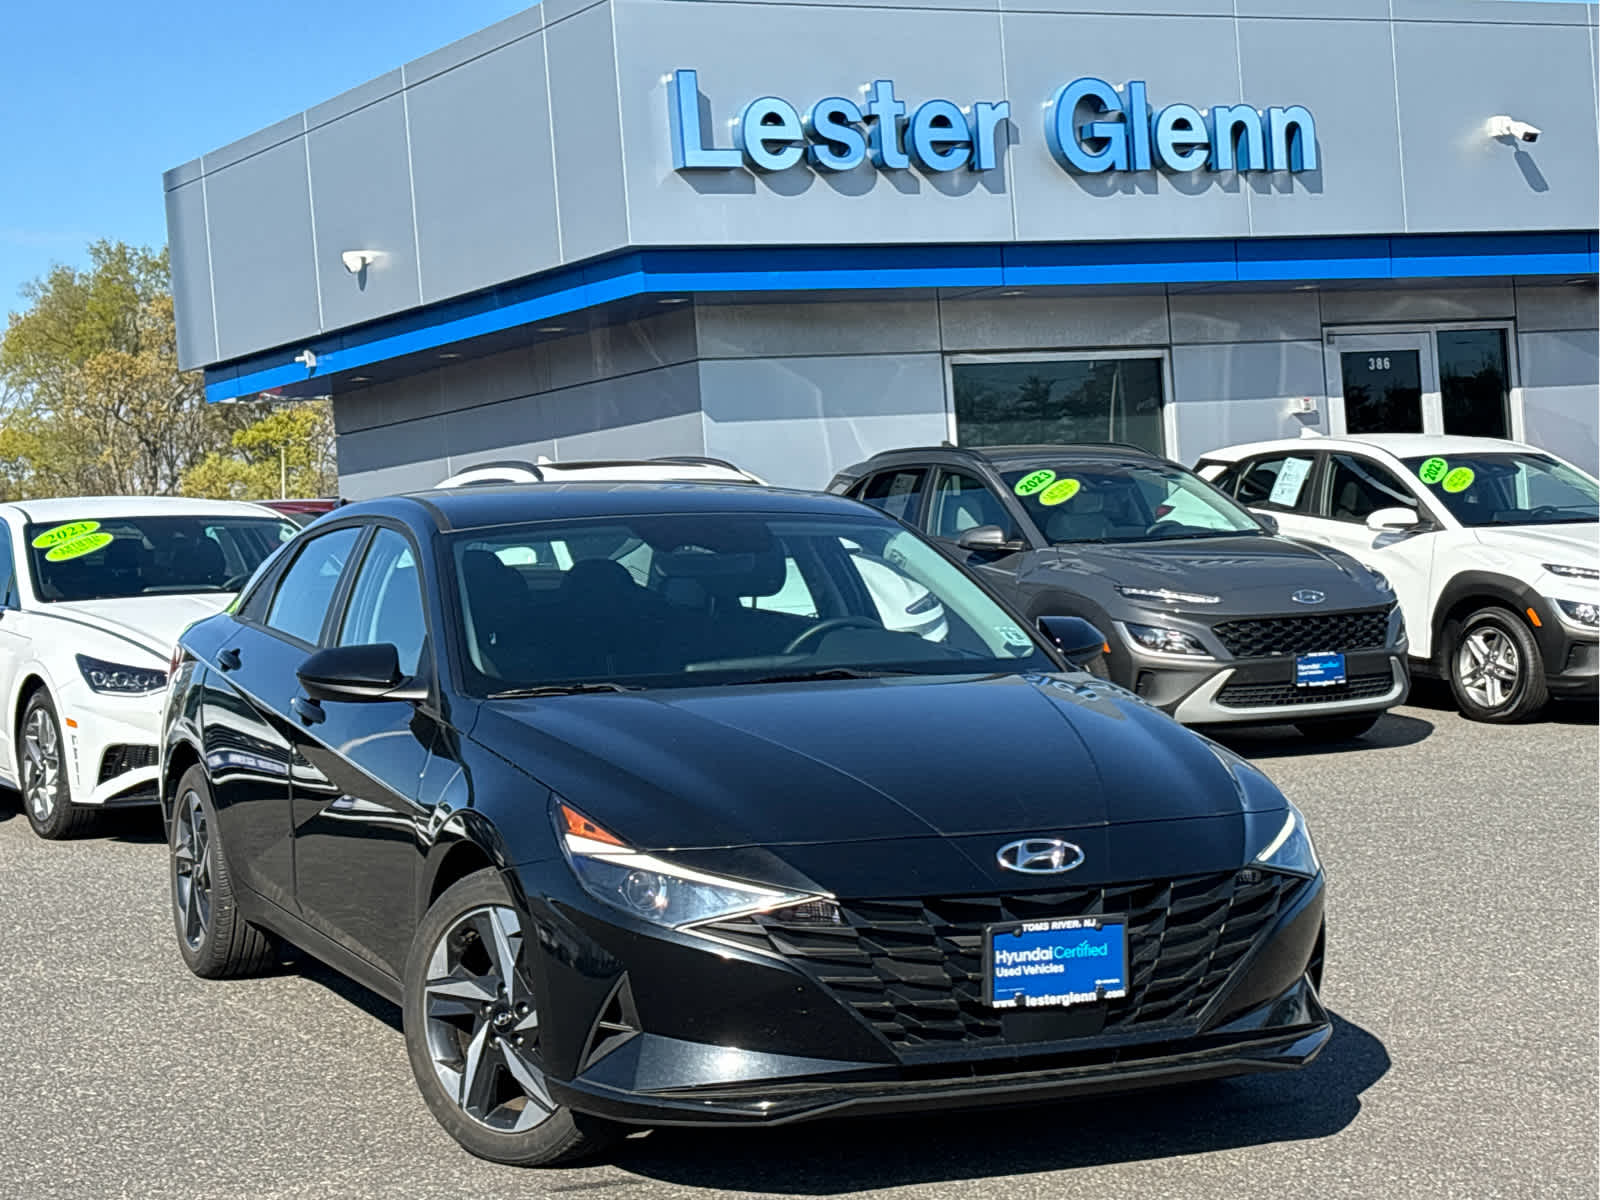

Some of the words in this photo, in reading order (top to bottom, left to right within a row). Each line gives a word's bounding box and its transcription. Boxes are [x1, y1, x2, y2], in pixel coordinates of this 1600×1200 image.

[671, 69, 1010, 172] Lester
[1048, 77, 1318, 174] Glenn
[1368, 357, 1391, 371] 386
[1019, 471, 1052, 493] 2023
[1022, 922, 1050, 932] TOMS
[1083, 918, 1097, 928] NJ
[995, 946, 1053, 966] Hyundai
[1054, 942, 1108, 959] Certified
[995, 965, 1022, 978] Used
[1022, 963, 1065, 976] Vehicles
